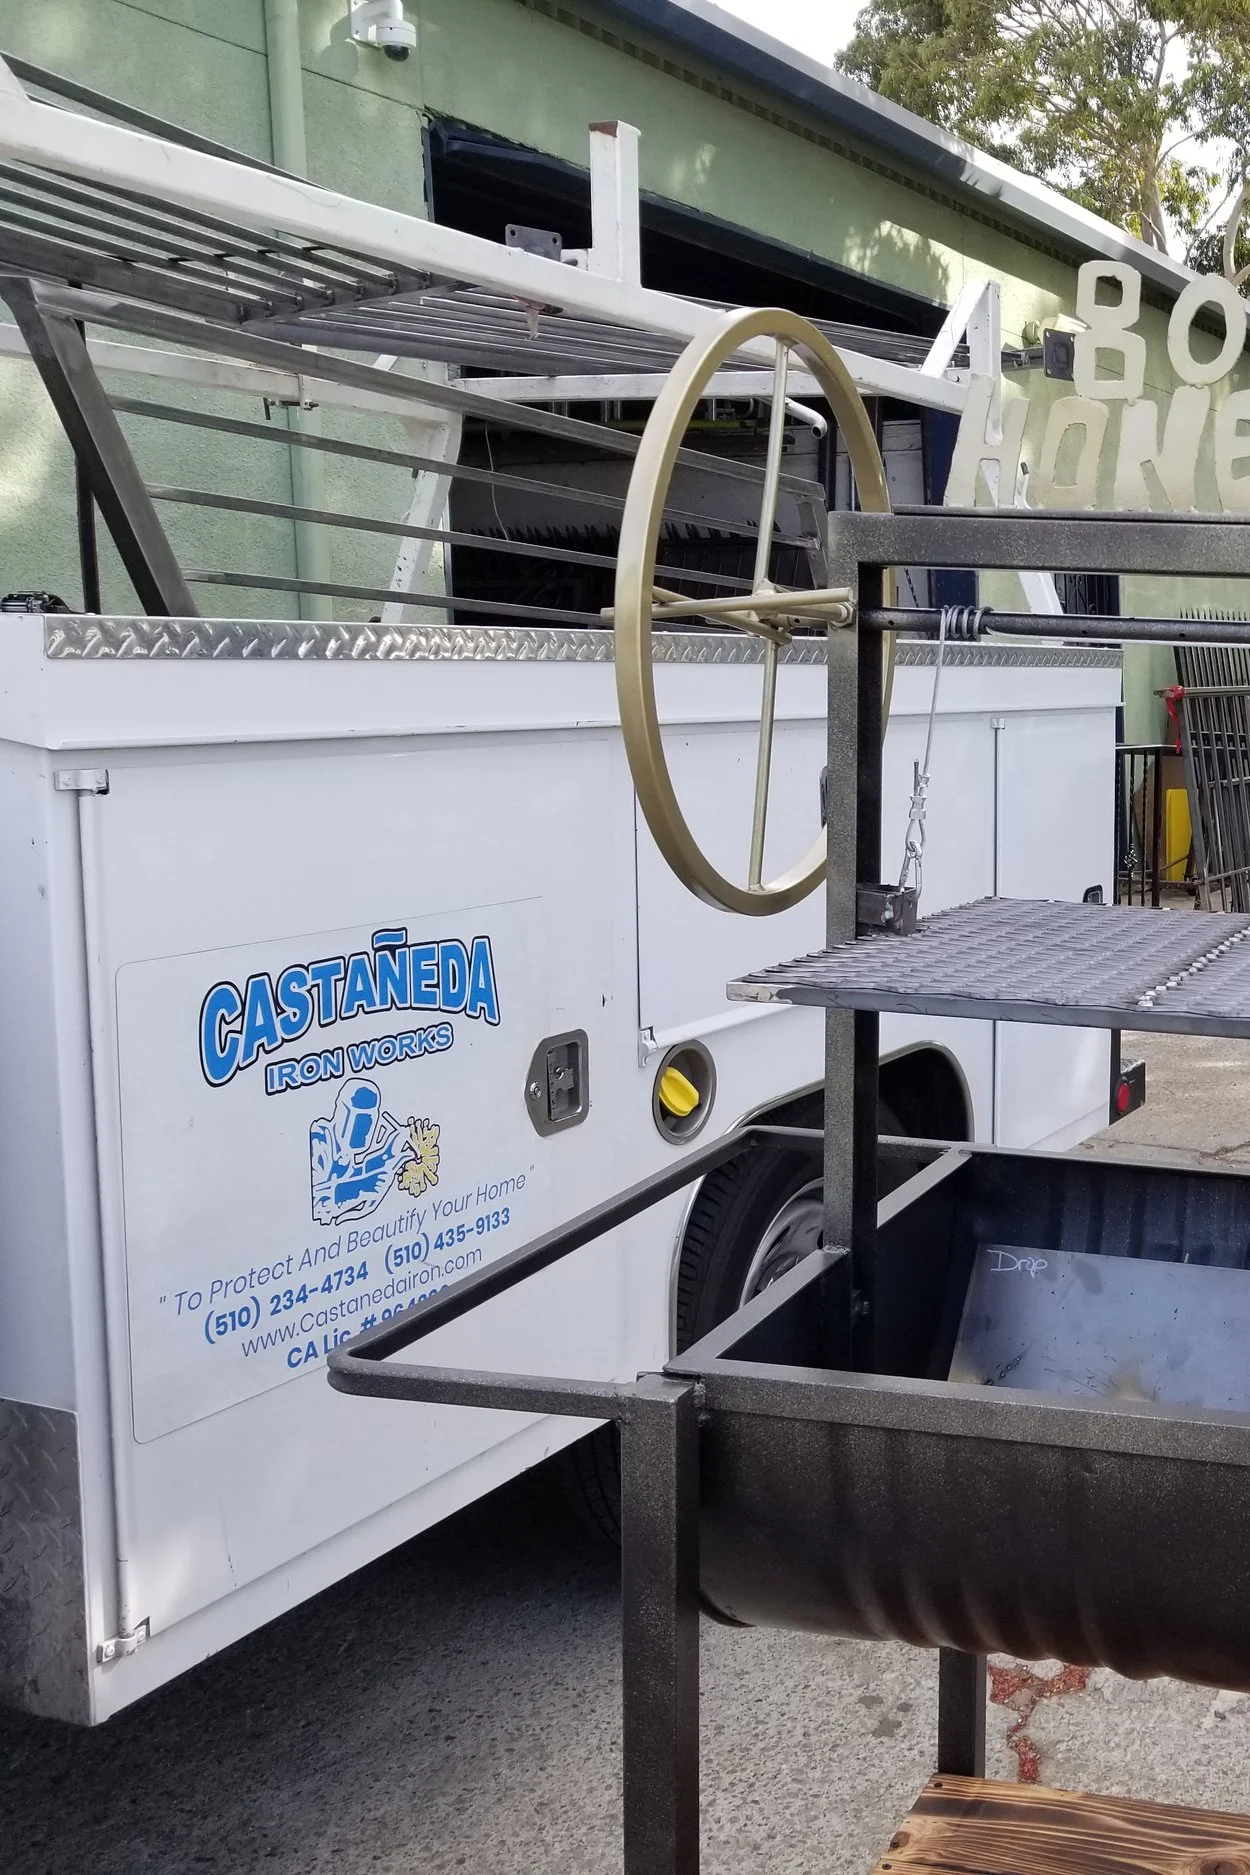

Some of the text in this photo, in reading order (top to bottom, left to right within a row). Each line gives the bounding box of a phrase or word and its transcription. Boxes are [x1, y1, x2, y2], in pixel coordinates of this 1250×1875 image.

[200, 927, 500, 1088] CASTAÑEDA
[265, 1022, 455, 1096] IRON WORKS
[175, 1290, 202, 1316] To
[209, 1254, 294, 1304] Protect
[298, 1235, 342, 1272] And
[346, 1208, 427, 1254] Beautify
[432, 1192, 473, 1221] Your
[475, 1174, 527, 1206] Home
[204, 1296, 261, 1344] (510)
[269, 1261, 369, 1316] 234-4734
[384, 1232, 430, 1275] (510)
[434, 1207, 510, 1251] 435-9133
[241, 1248, 482, 1357] www.Castanedairon.com
[286, 1340, 319, 1369] CA
